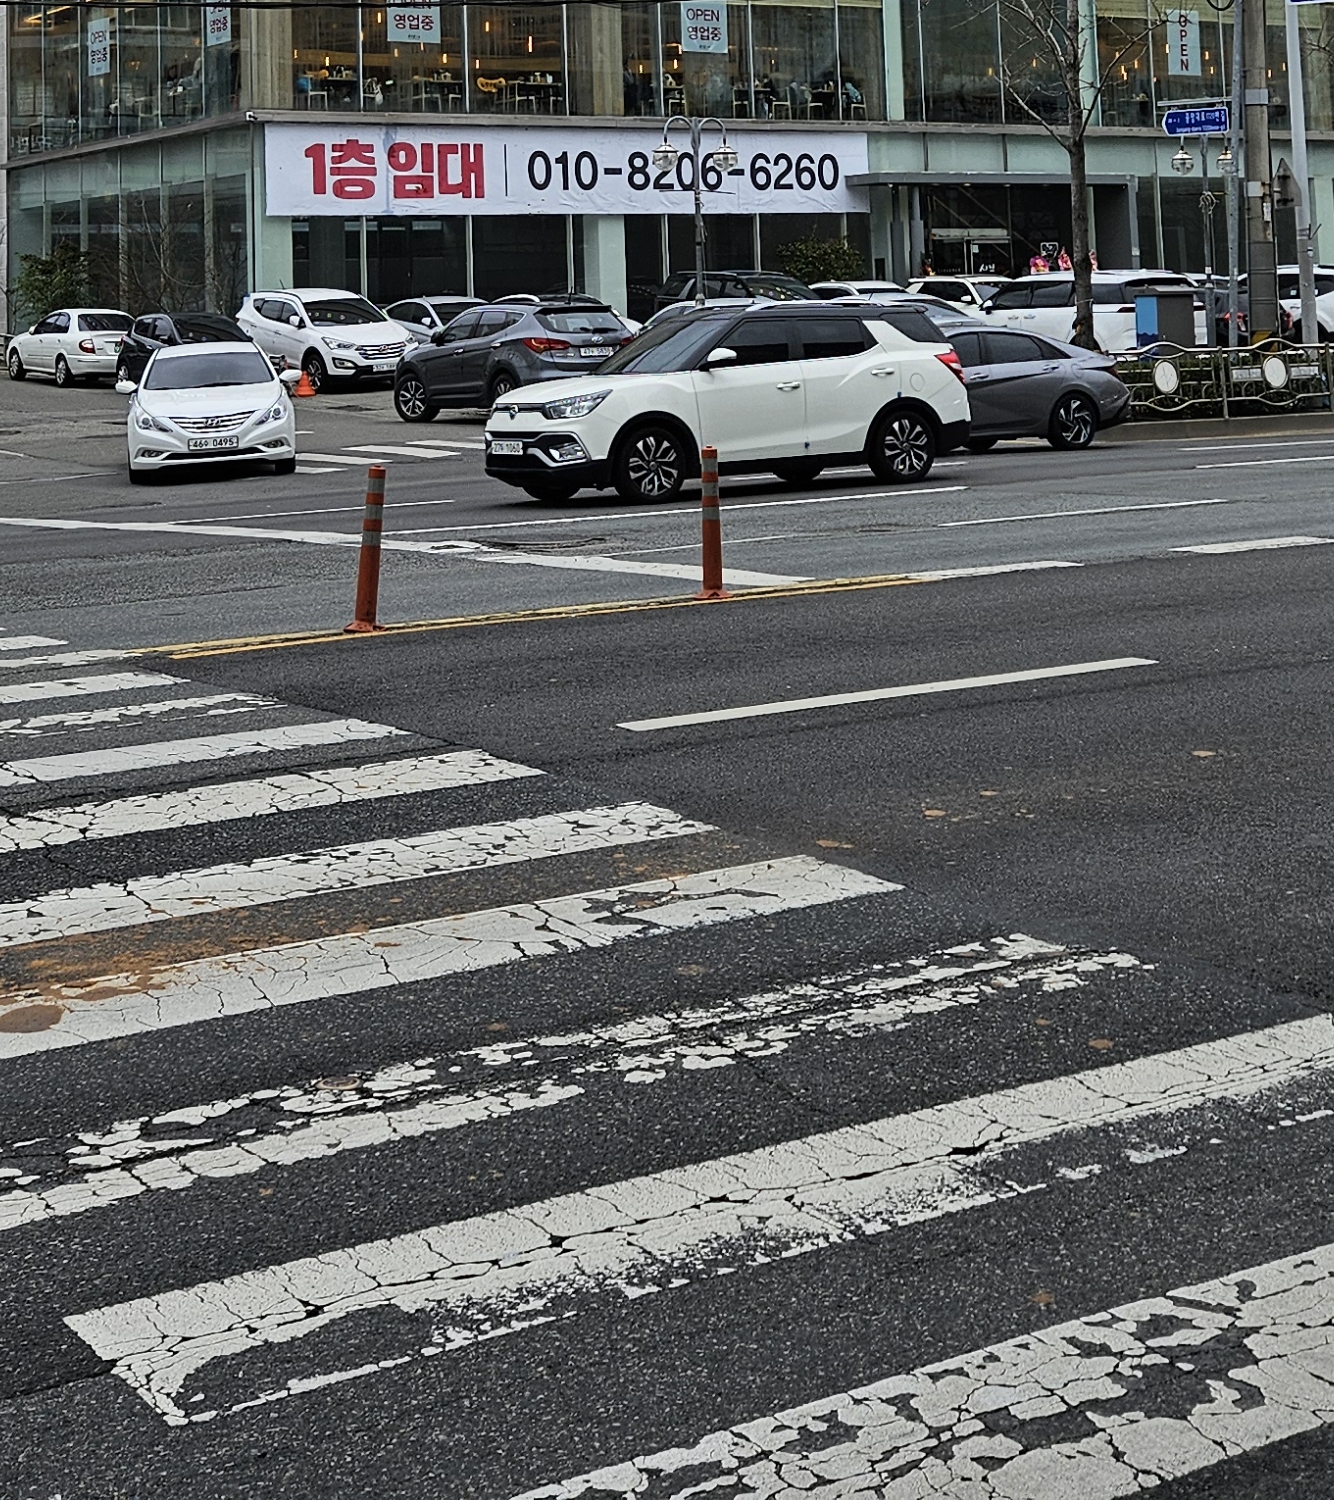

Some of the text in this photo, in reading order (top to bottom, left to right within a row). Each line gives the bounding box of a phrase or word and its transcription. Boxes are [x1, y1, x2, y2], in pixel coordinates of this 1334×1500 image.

[393, 14, 434, 31] 영업중
[686, 8, 720, 22] OPEN
[90, 30, 107, 45] OPEN
[687, 26, 722, 41] 영업중
[1178, 14, 1189, 71] OPEN
[90, 47, 108, 65] 영업중
[304, 139, 377, 200] 1층
[387, 141, 485, 200] 임대
[213, 437, 235, 447] 0495
